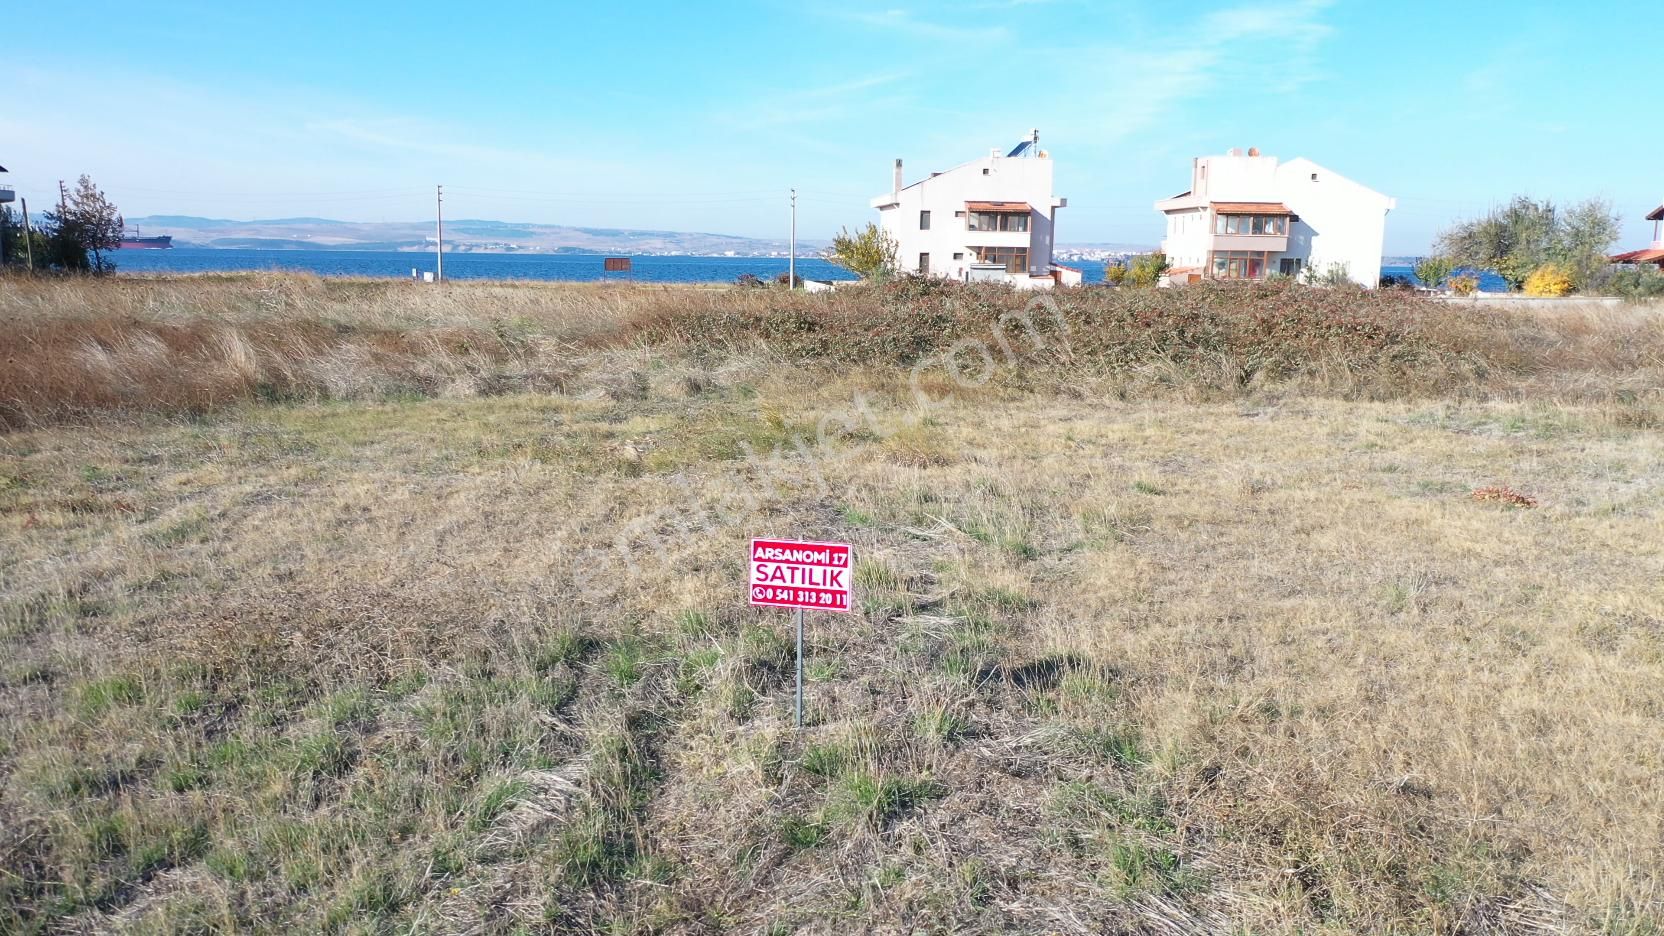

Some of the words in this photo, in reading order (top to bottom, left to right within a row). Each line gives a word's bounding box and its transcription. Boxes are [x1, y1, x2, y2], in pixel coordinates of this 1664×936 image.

[754, 547, 830, 564] ARSANOMİ
[832, 553, 847, 565] 17
[755, 564, 843, 588] SATILIK
[766, 588, 773, 599] 0
[776, 589, 794, 601] 541
[797, 591, 817, 603] 313
[819, 592, 832, 604] 20
[836, 594, 847, 605] 11
